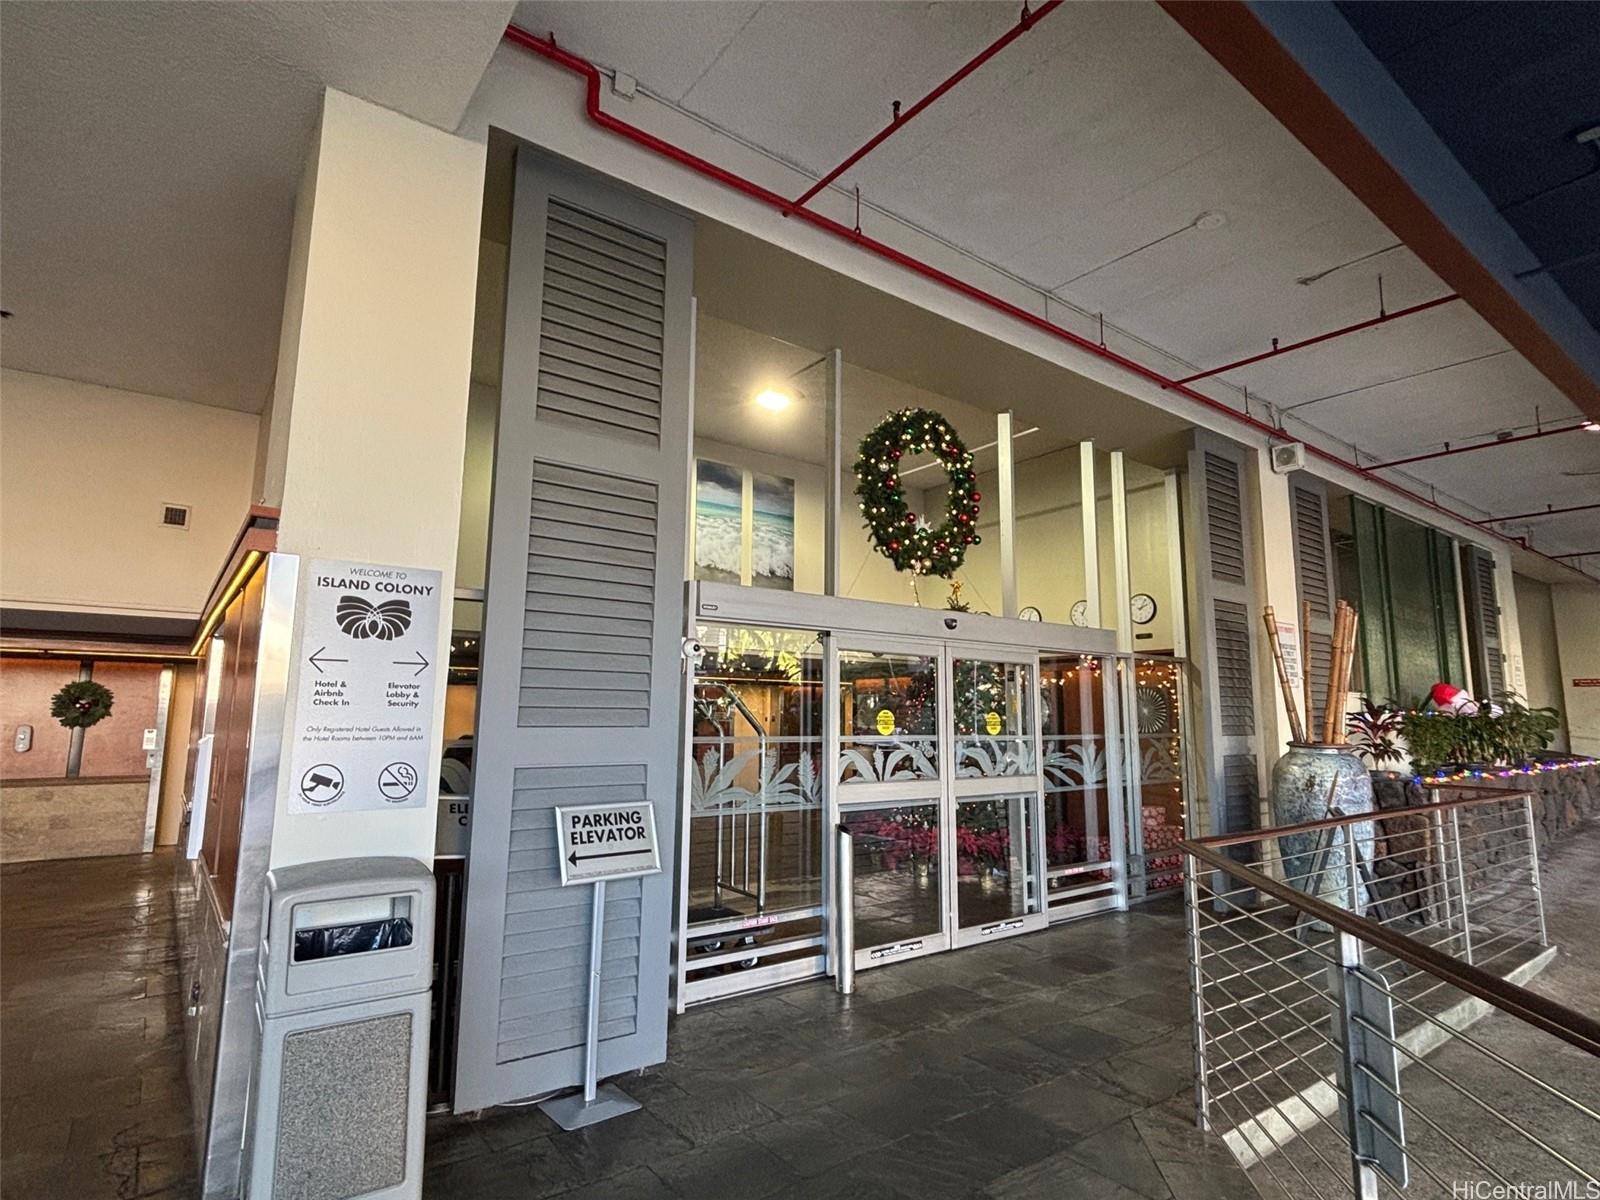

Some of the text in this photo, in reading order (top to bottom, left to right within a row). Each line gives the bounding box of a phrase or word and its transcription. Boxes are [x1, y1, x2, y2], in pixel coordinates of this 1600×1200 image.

[349, 567, 408, 580] WELCOME TO
[317, 576, 434, 596] ISLAND COLONY
[314, 680, 338, 688] Hotel
[388, 682, 420, 690] Elevator
[314, 689, 344, 697] Airbnb
[386, 691, 419, 699] Lobby &
[313, 698, 339, 706] Check
[387, 700, 419, 709] Security
[306, 725, 321, 734] Only
[571, 811, 642, 829] PARKING
[570, 826, 647, 846] ELEVATOR
